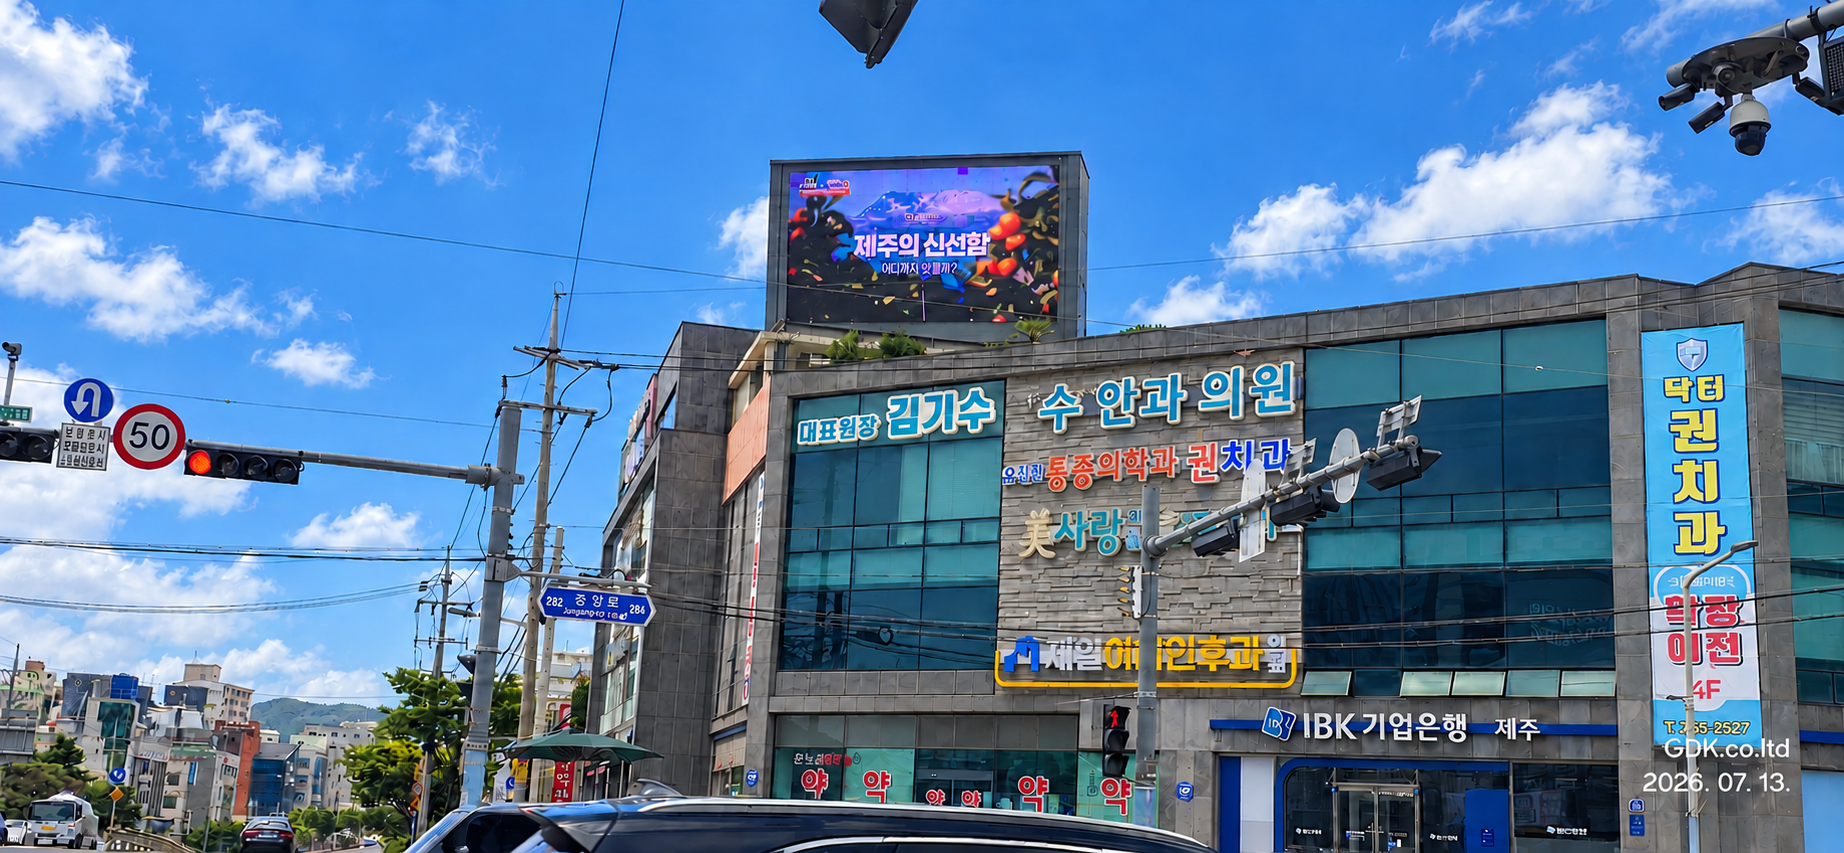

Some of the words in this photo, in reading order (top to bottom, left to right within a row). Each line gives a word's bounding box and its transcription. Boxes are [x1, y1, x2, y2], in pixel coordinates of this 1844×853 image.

[853, 233, 919, 258] 제주의
[923, 232, 990, 257] 신선함
[1037, 382, 1084, 434] 수
[1198, 360, 1296, 420] 의원
[1664, 374, 1725, 403] 닥터
[797, 413, 881, 446] 대표원장
[886, 386, 996, 439] 김기수
[129, 421, 170, 451] 50
[1186, 438, 1292, 484] 권치과
[1669, 408, 1728, 556] 권치과
[546, 596, 563, 607] 282
[1667, 632, 1741, 665] 이전
[1693, 679, 1721, 699] 4F
[1303, 712, 1357, 741] IBK
[1362, 712, 1467, 743] 기업은행
[1494, 717, 1541, 741] 제주
[863, 770, 892, 803] 약
[1018, 775, 1049, 812] 약
[1100, 777, 1132, 816] 약
